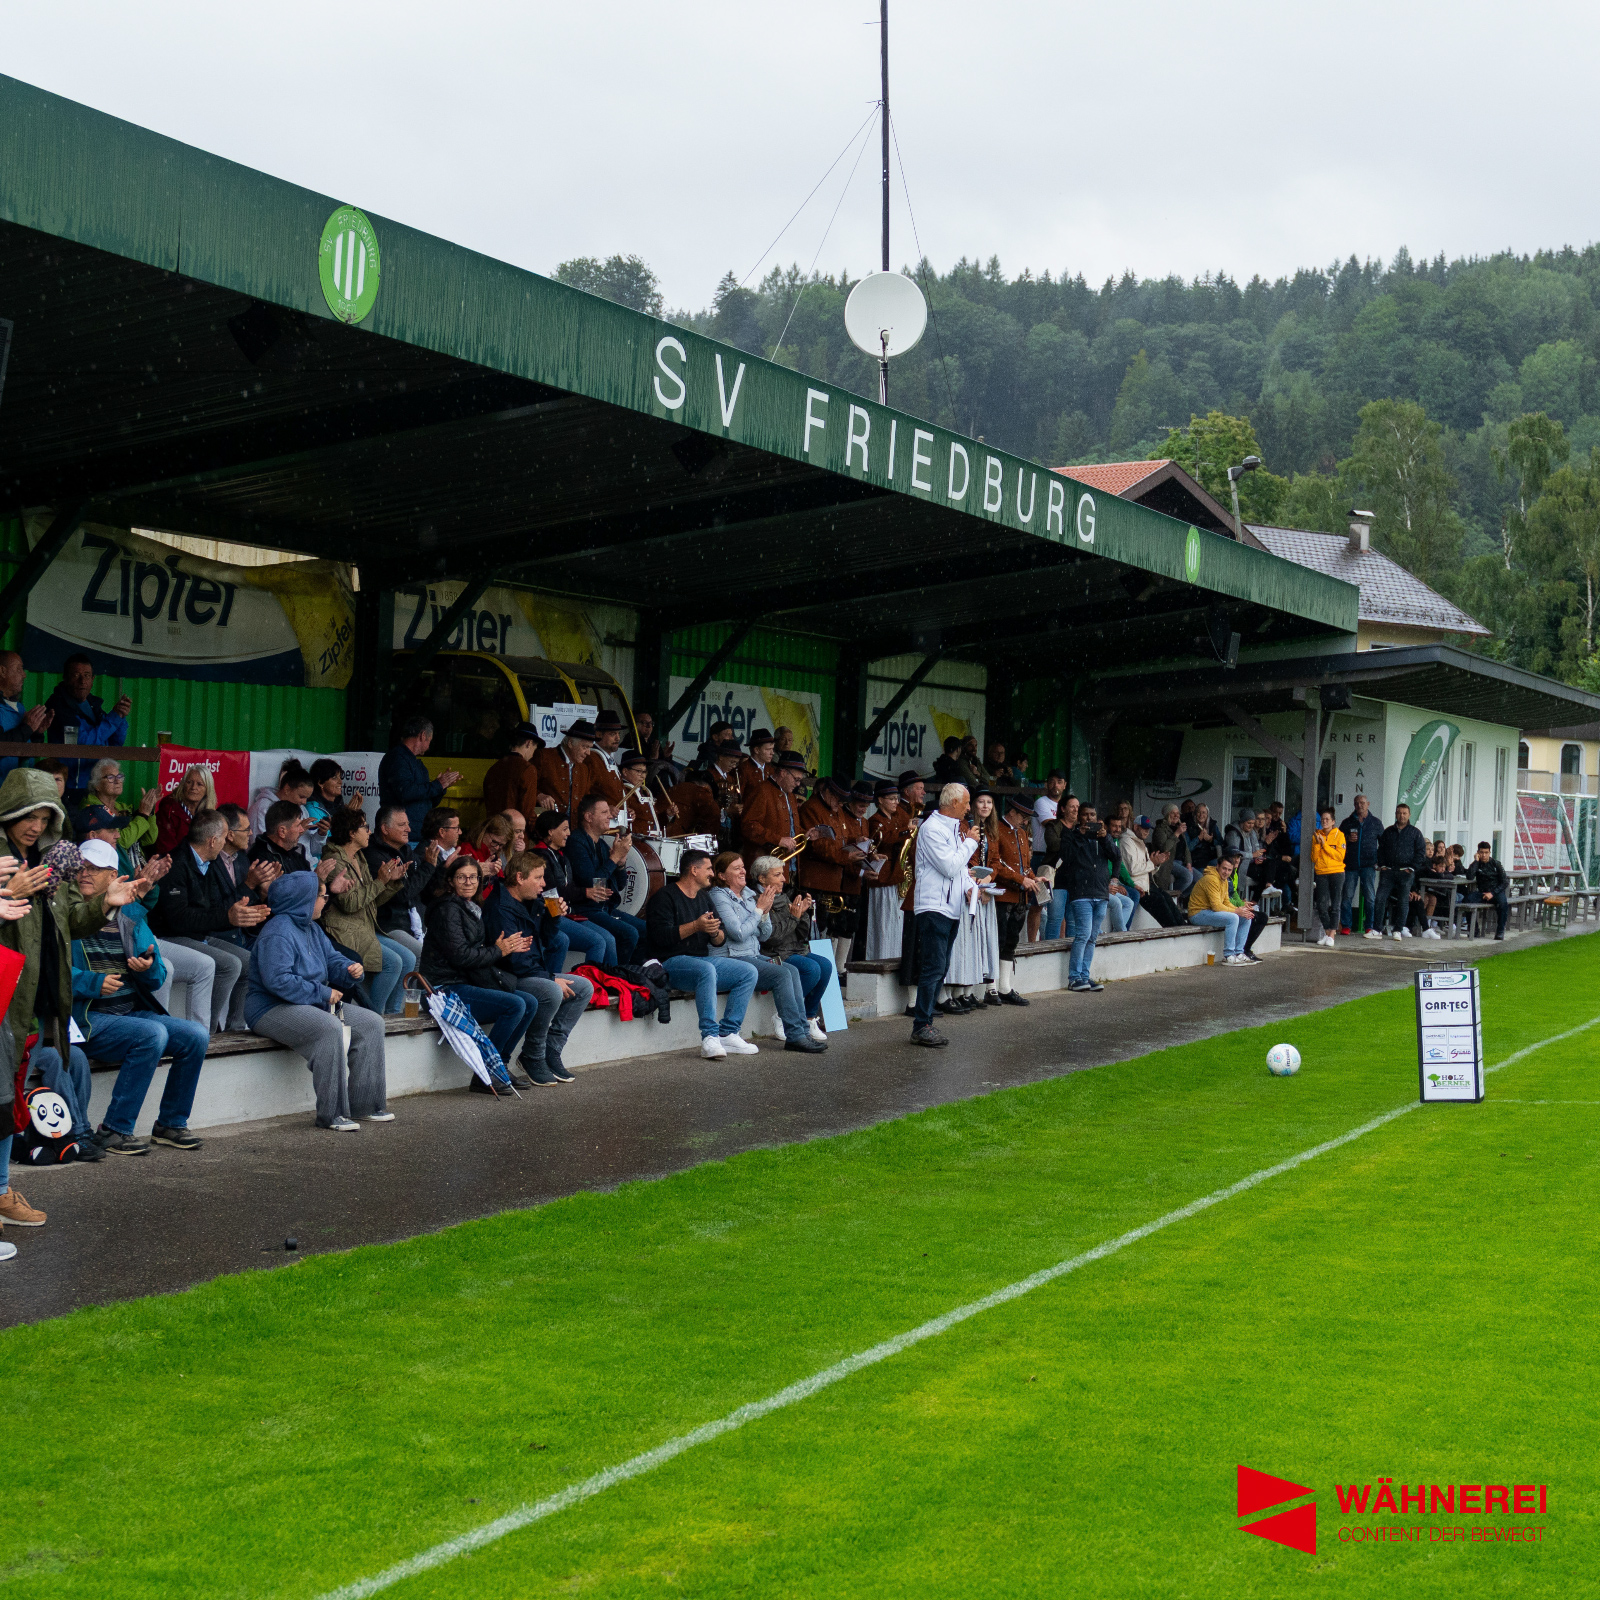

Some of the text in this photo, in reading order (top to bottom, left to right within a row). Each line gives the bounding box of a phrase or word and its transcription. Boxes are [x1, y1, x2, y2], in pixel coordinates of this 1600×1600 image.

[653, 336, 1097, 545] SV FRIEDBURG
[80, 531, 240, 645] Zipfer
[318, 616, 353, 676] Zipfer
[168, 758, 184, 774] Du
[1400, 792, 1409, 803] SV
[1424, 1001, 1469, 1012] CAR-TEC
